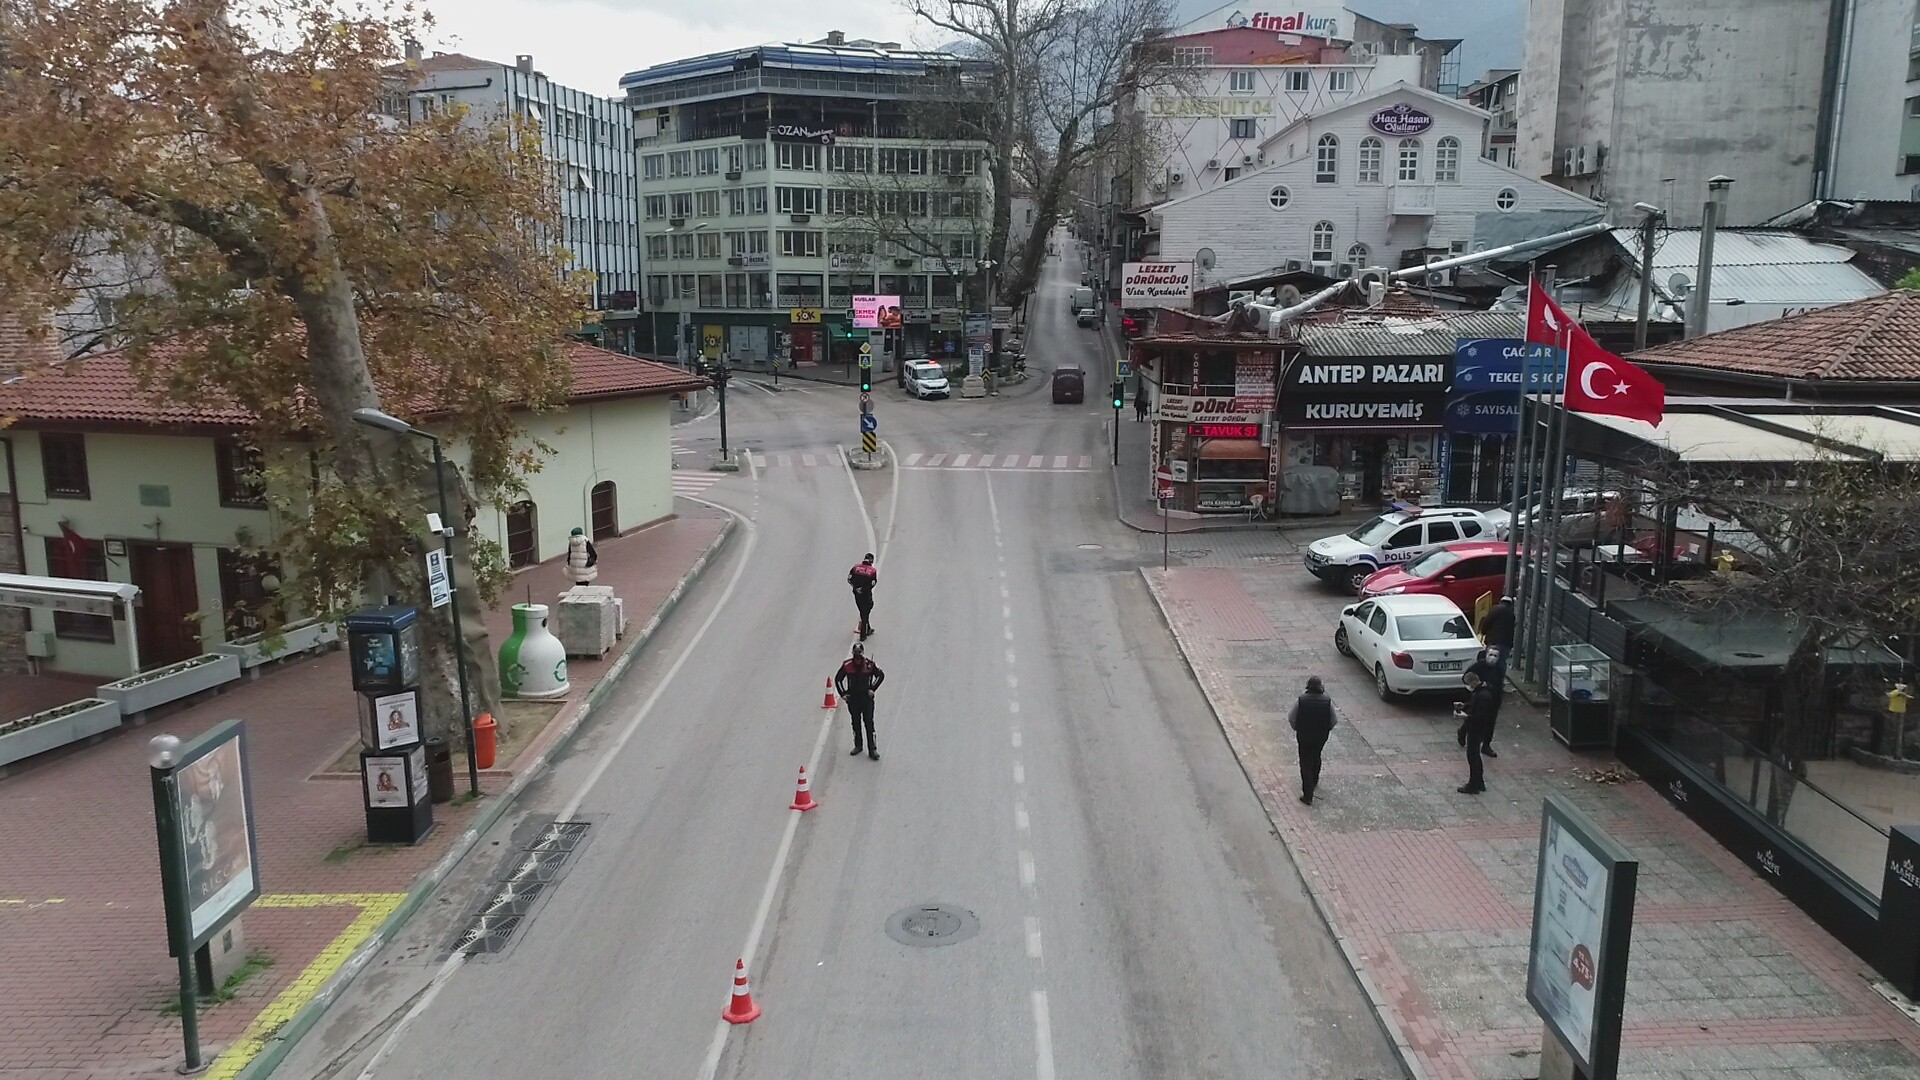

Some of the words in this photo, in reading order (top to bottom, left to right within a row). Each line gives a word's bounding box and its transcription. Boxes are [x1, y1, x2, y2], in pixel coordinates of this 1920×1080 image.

[1251, 12, 1304, 30] final
[1398, 113, 1430, 124] Hasan
[777, 124, 808, 137] OZAN
[1138, 265, 1176, 273] LEZZET
[1125, 274, 1189, 284] DÜRÜMCÜSÜ
[1125, 287, 1145, 296] Usta
[1147, 287, 1187, 297] Kardeşler
[1298, 366, 1365, 384] ANTEP
[1371, 364, 1445, 383] PAZARI
[1306, 398, 1424, 419] KURUYEMİŞ
[1203, 426, 1243, 436] TAVUK
[1384, 550, 1412, 562] POLİS
